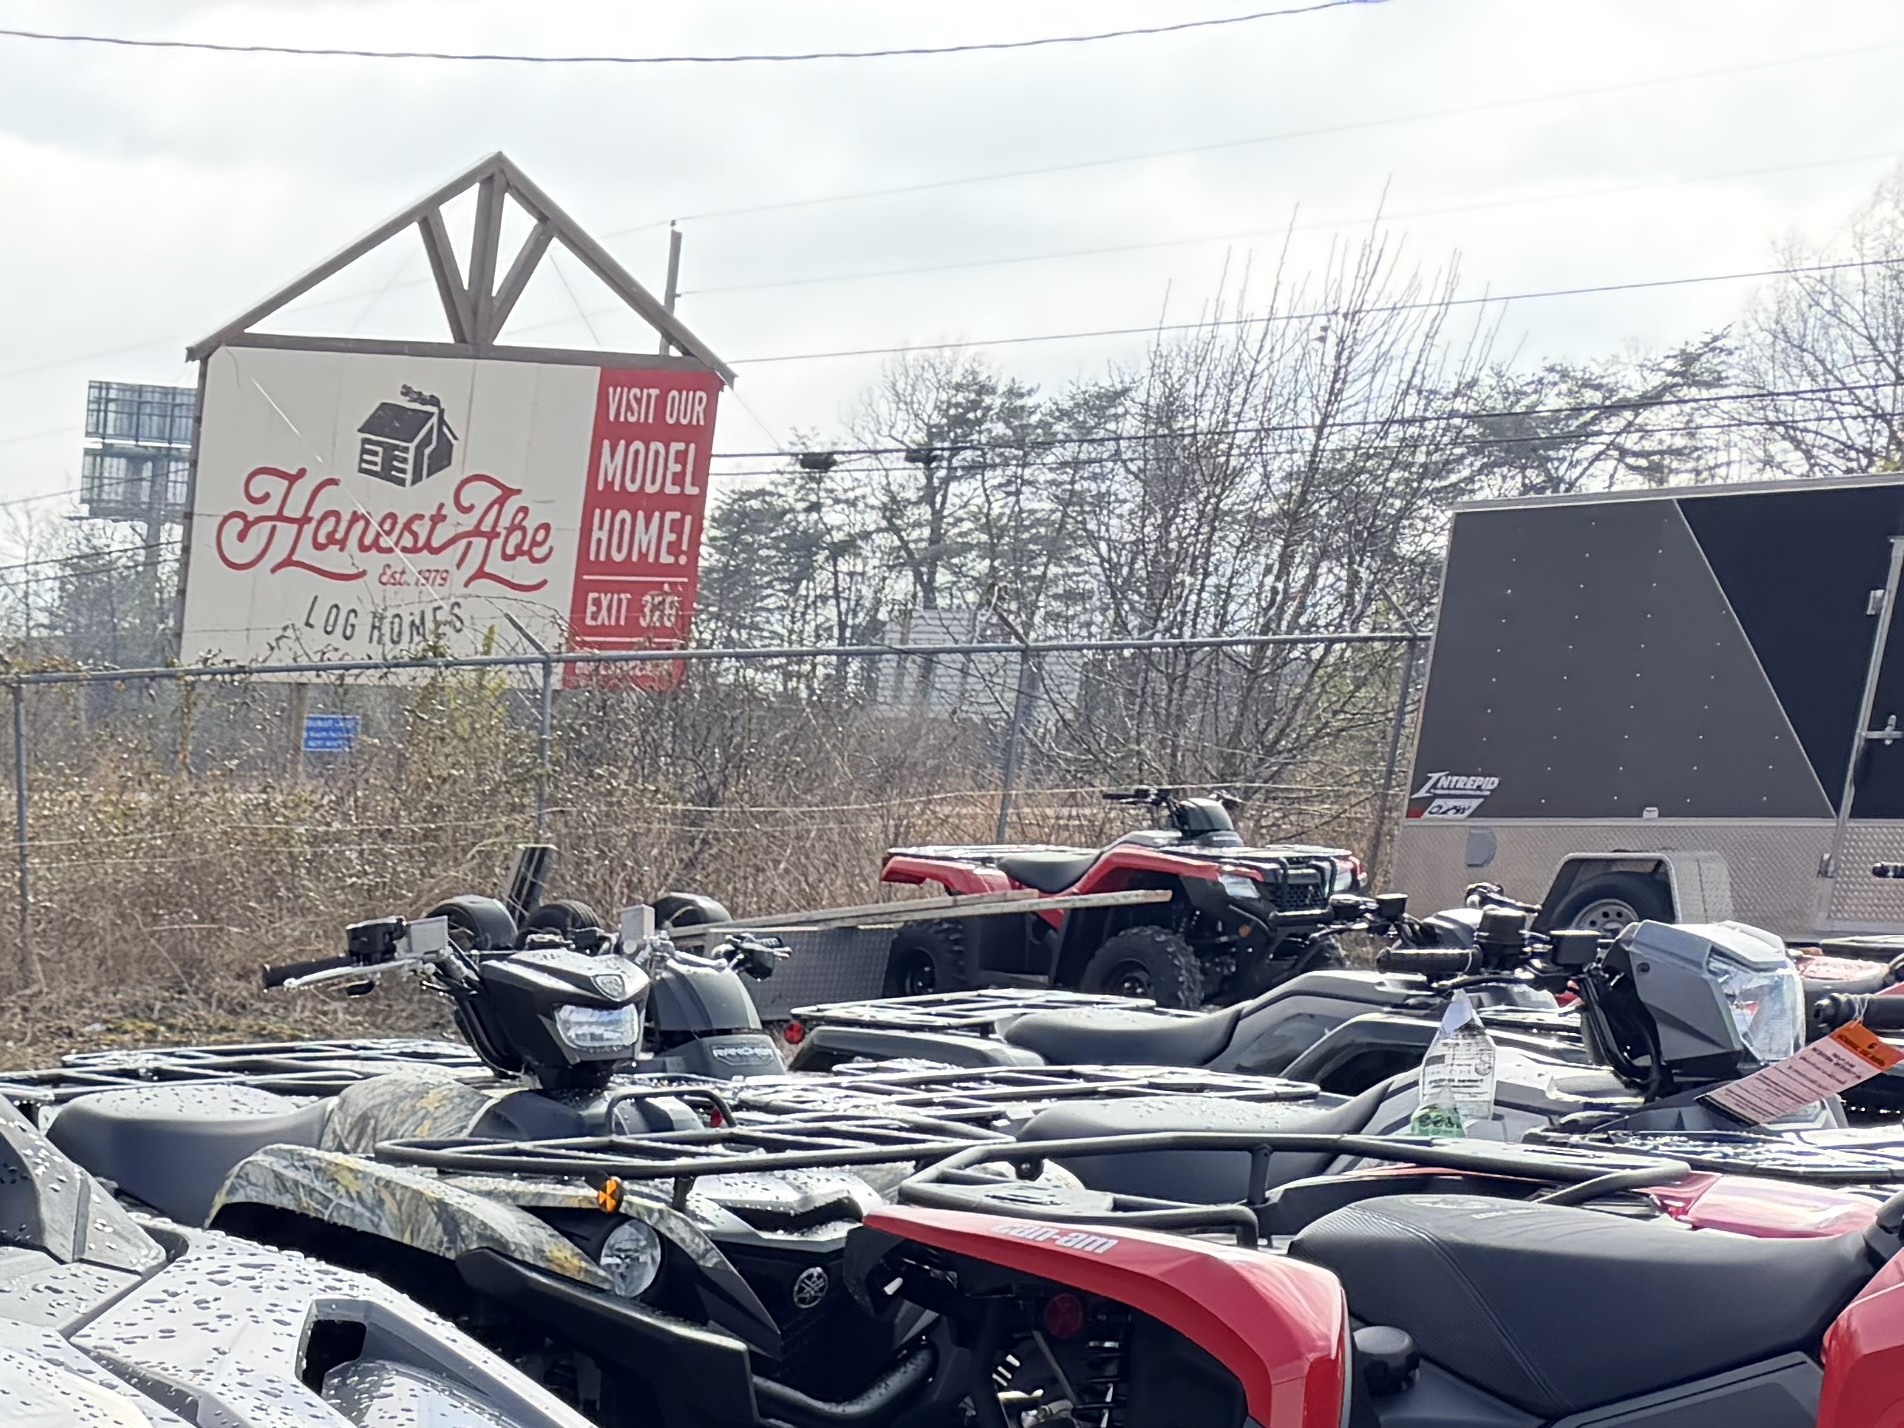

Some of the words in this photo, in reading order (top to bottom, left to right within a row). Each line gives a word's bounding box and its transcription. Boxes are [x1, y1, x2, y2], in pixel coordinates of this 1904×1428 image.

[608, 386, 660, 424] VISIT
[665, 389, 707, 426] OUR
[597, 439, 700, 495] MODEL
[216, 466, 450, 581] Honest
[452, 473, 554, 592] Abe
[589, 508, 692, 565] HOME!
[378, 564, 410, 586] Est.
[304, 595, 359, 641] LOG
[585, 592, 631, 626] EXIT
[1410, 771, 1500, 798] INTREPID
